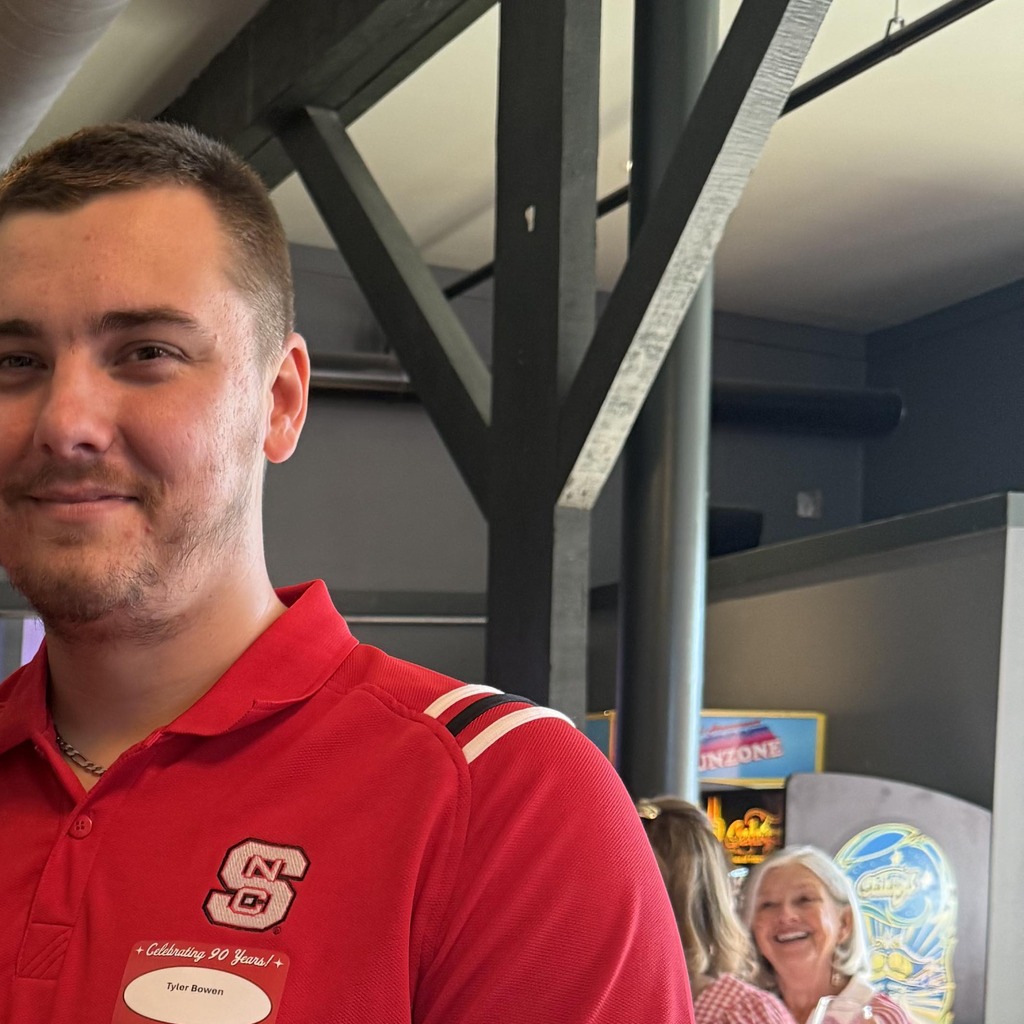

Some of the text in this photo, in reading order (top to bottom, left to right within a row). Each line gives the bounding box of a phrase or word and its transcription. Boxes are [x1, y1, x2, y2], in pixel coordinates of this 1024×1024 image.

[146, 942, 274, 967] Celebrating 90 Years!
[167, 982, 224, 996] Tyler Bowen
